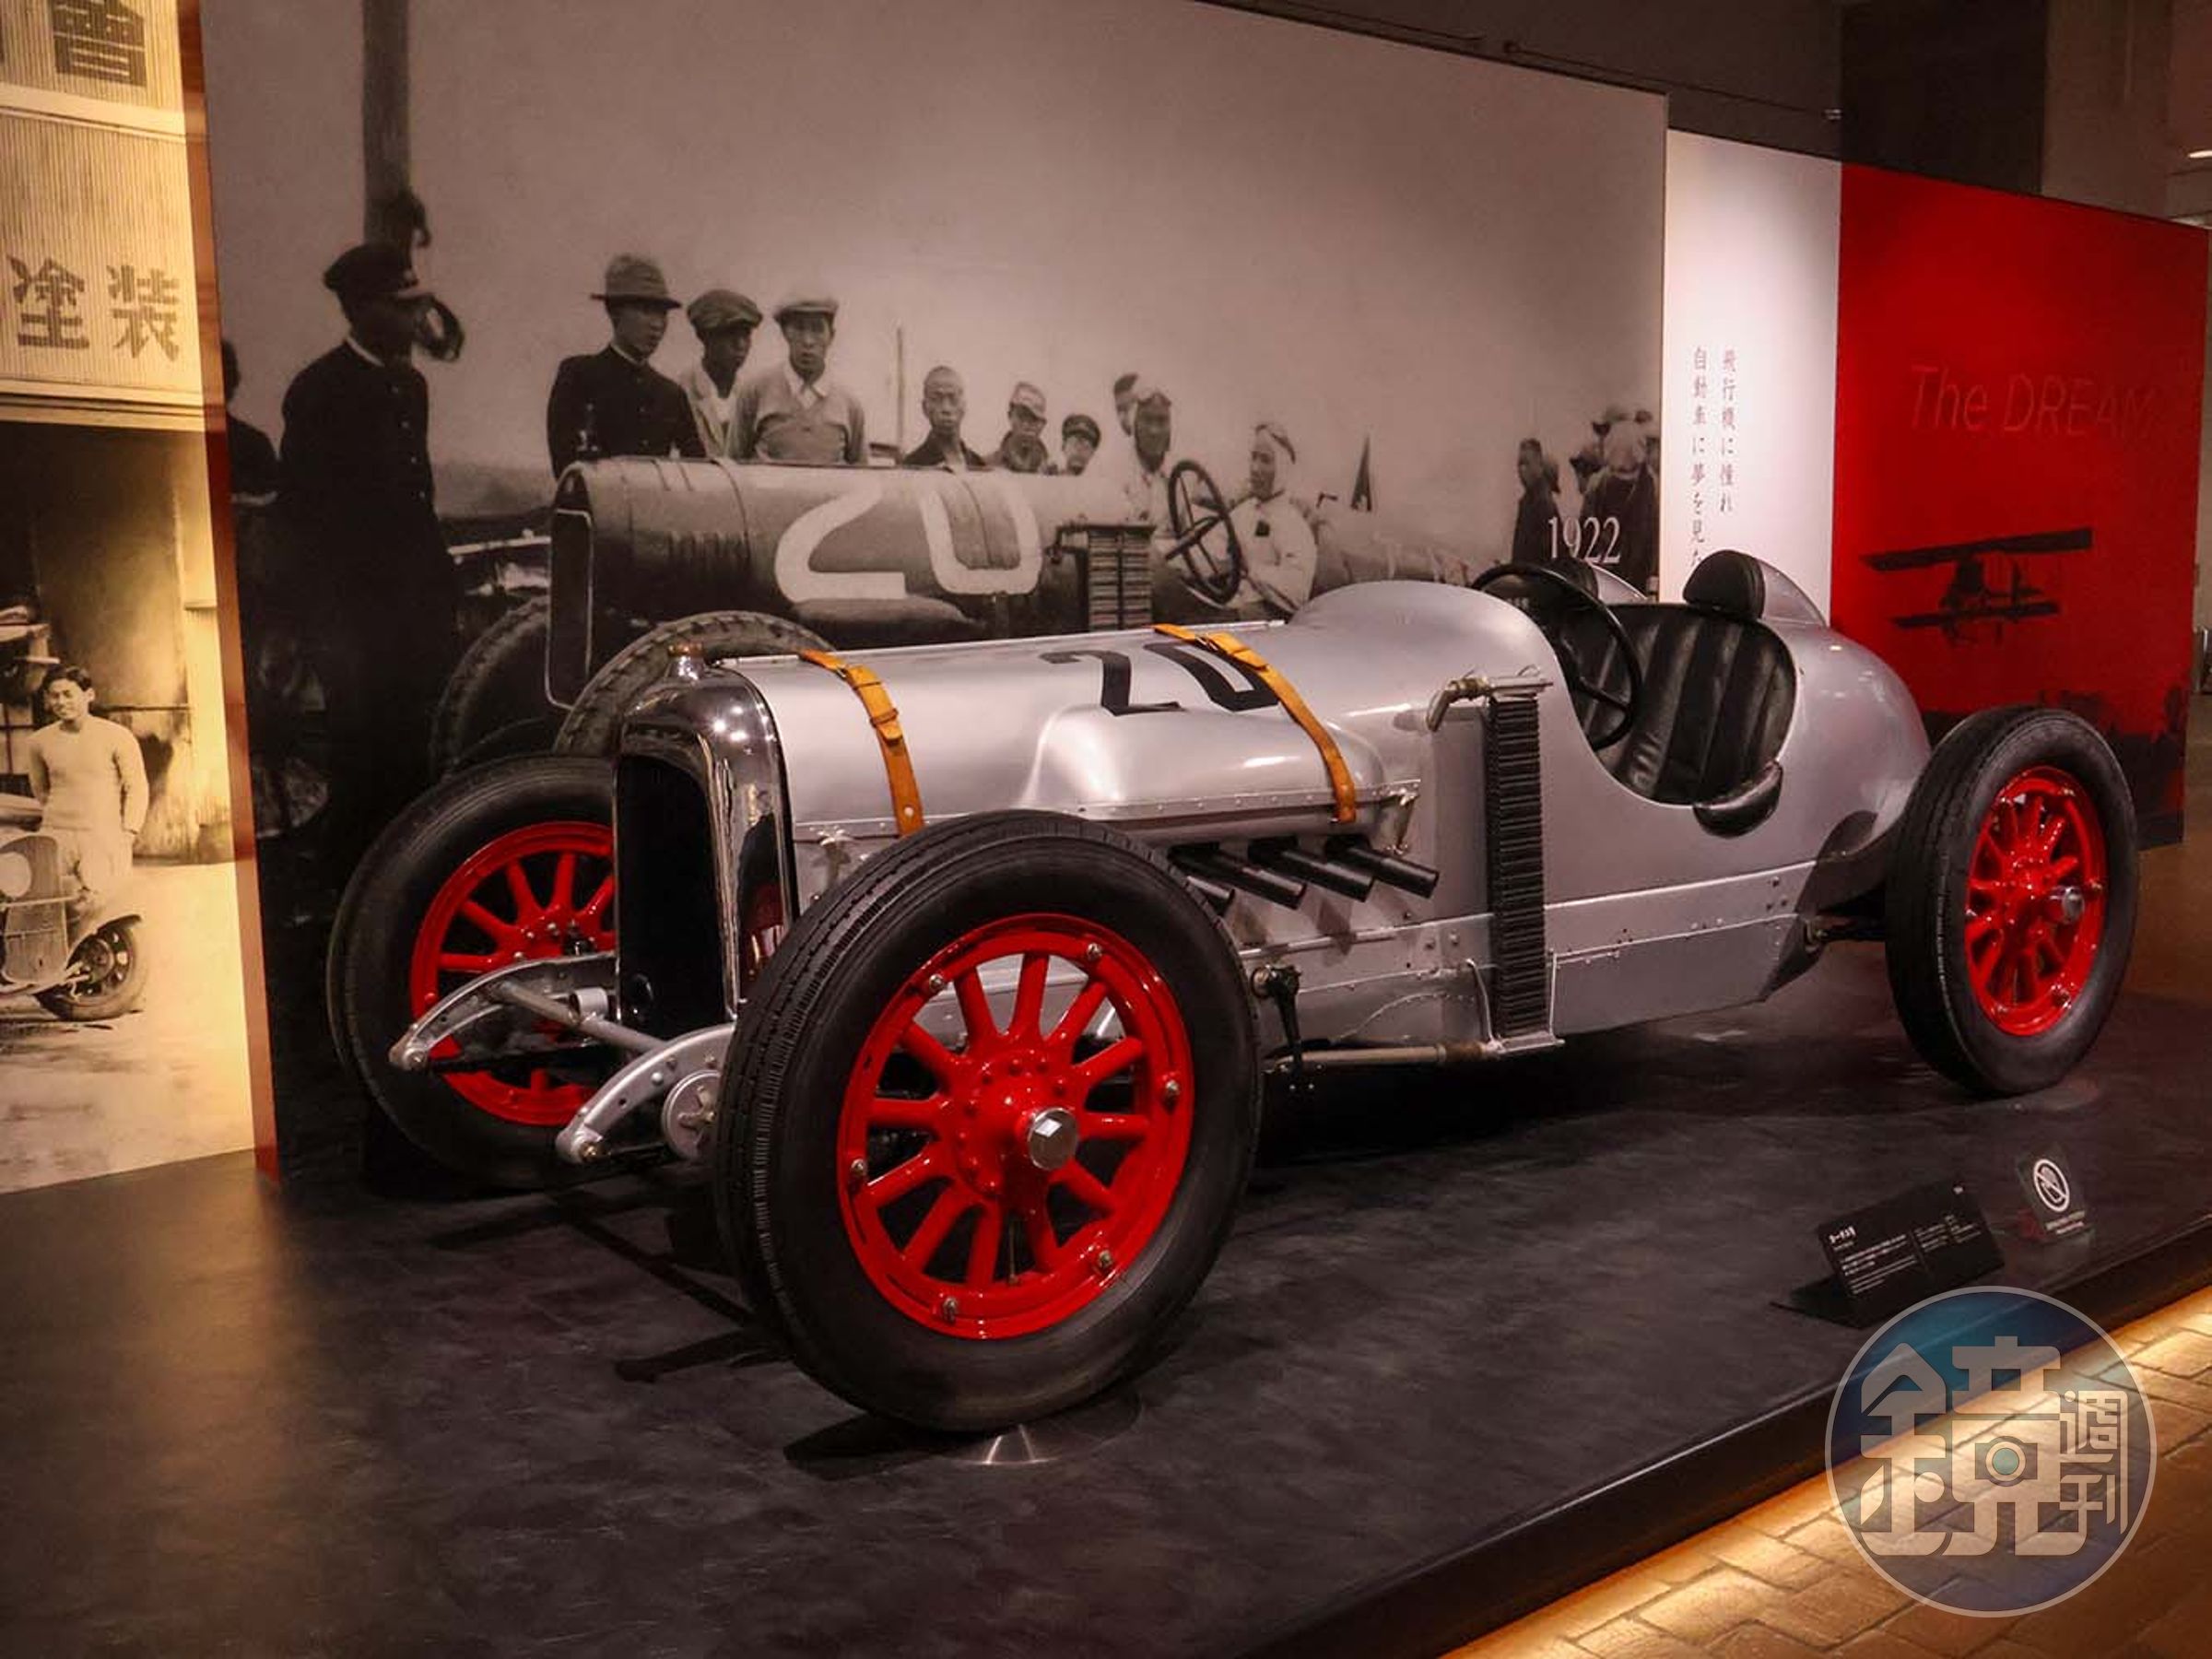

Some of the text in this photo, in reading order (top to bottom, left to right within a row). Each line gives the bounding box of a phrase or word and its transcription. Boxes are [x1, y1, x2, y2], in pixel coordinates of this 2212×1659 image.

[6, 254, 181, 362] 塗装
[1910, 363, 1988, 431] The
[775, 473, 1042, 603] 20
[1548, 516, 1620, 563] 1922
